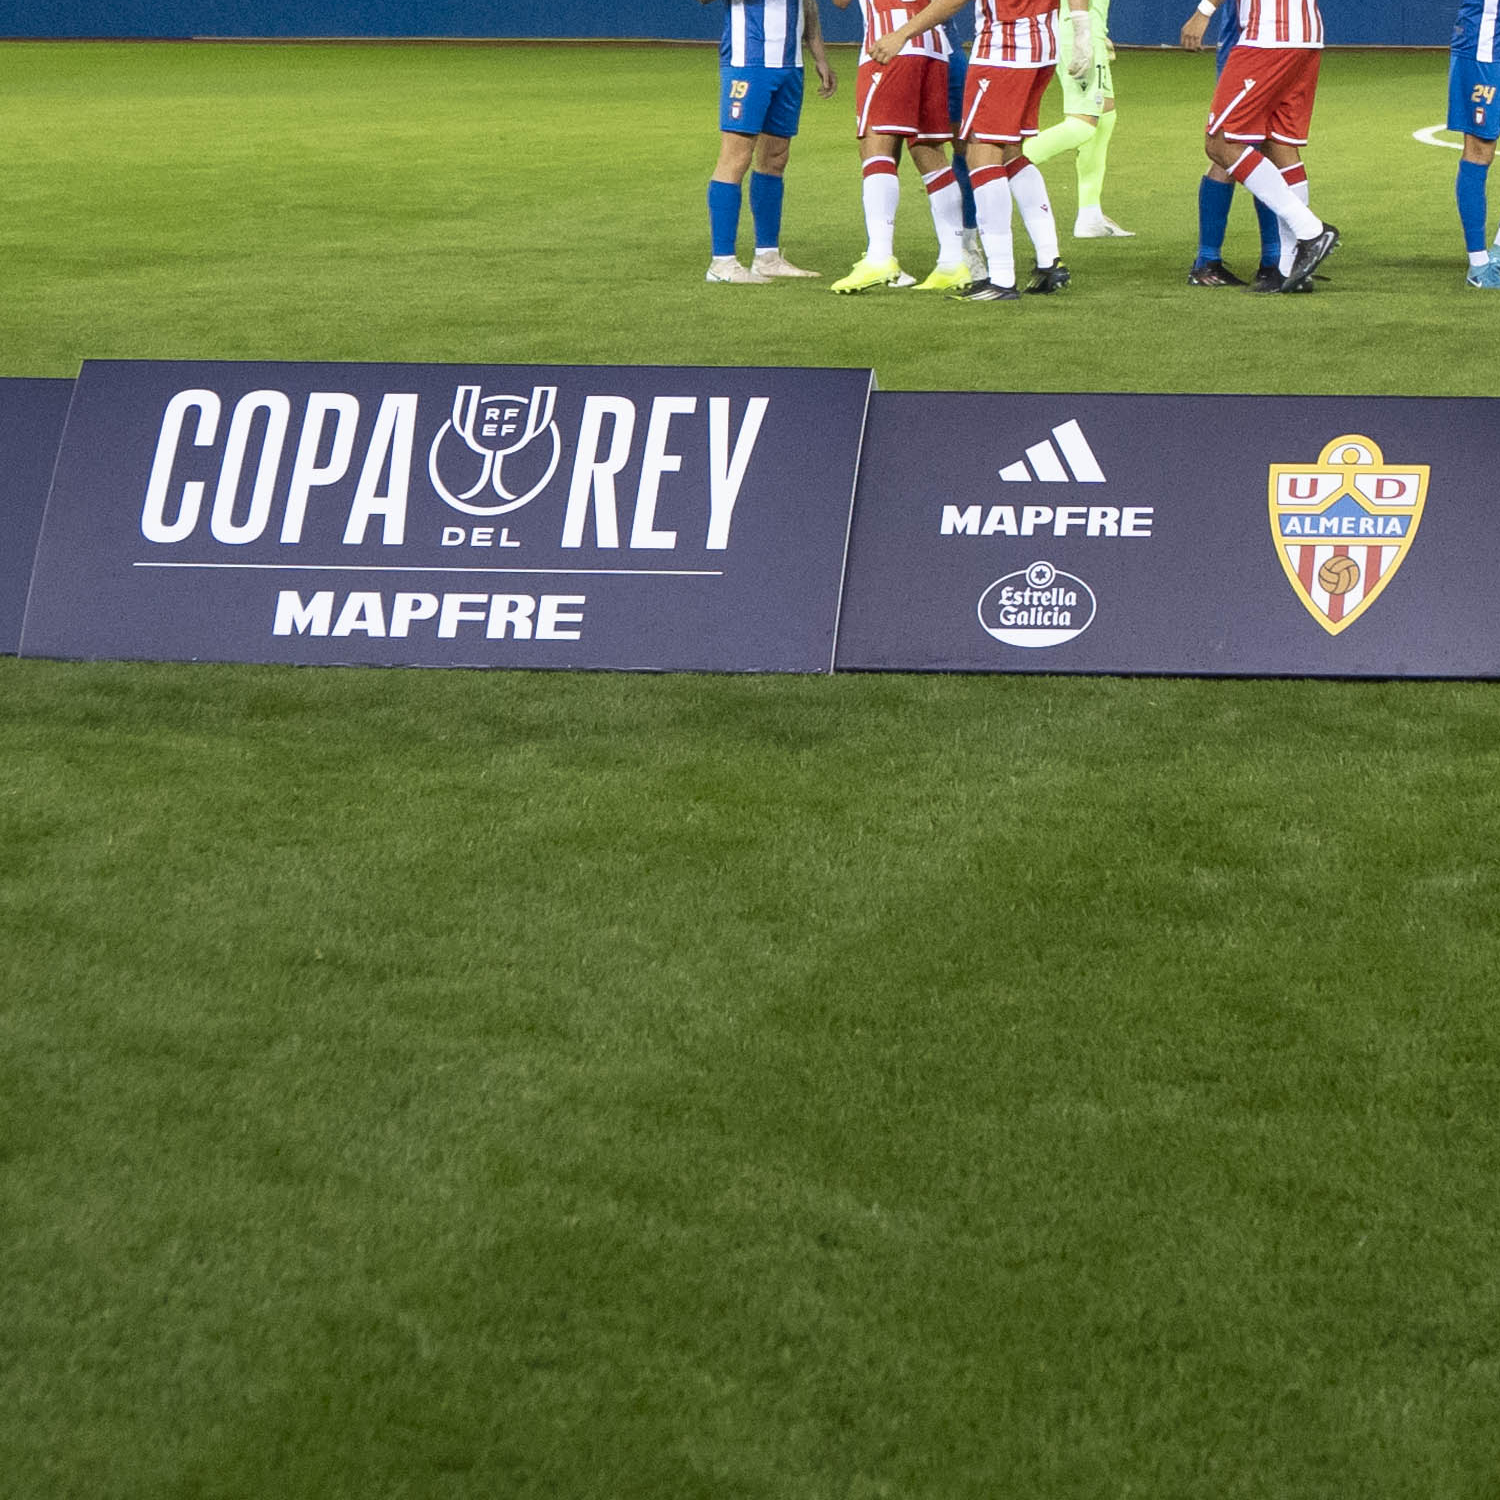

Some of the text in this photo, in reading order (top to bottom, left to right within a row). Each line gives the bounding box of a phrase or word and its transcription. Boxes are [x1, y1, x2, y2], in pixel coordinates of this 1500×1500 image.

[729, 79, 750, 99] 19
[1470, 84, 1497, 105] 24
[486, 407, 520, 421] RF
[482, 423, 517, 437] EF
[139, 389, 770, 550] COPA REY
[1288, 477, 1407, 500] U D
[940, 505, 1154, 537] MAPFRE
[1284, 516, 1403, 535] ALMERIA
[441, 526, 522, 547] DEL
[998, 586, 1077, 607] Estrella
[273, 590, 587, 641] MAPFRE
[999, 606, 1071, 627] Galicia
